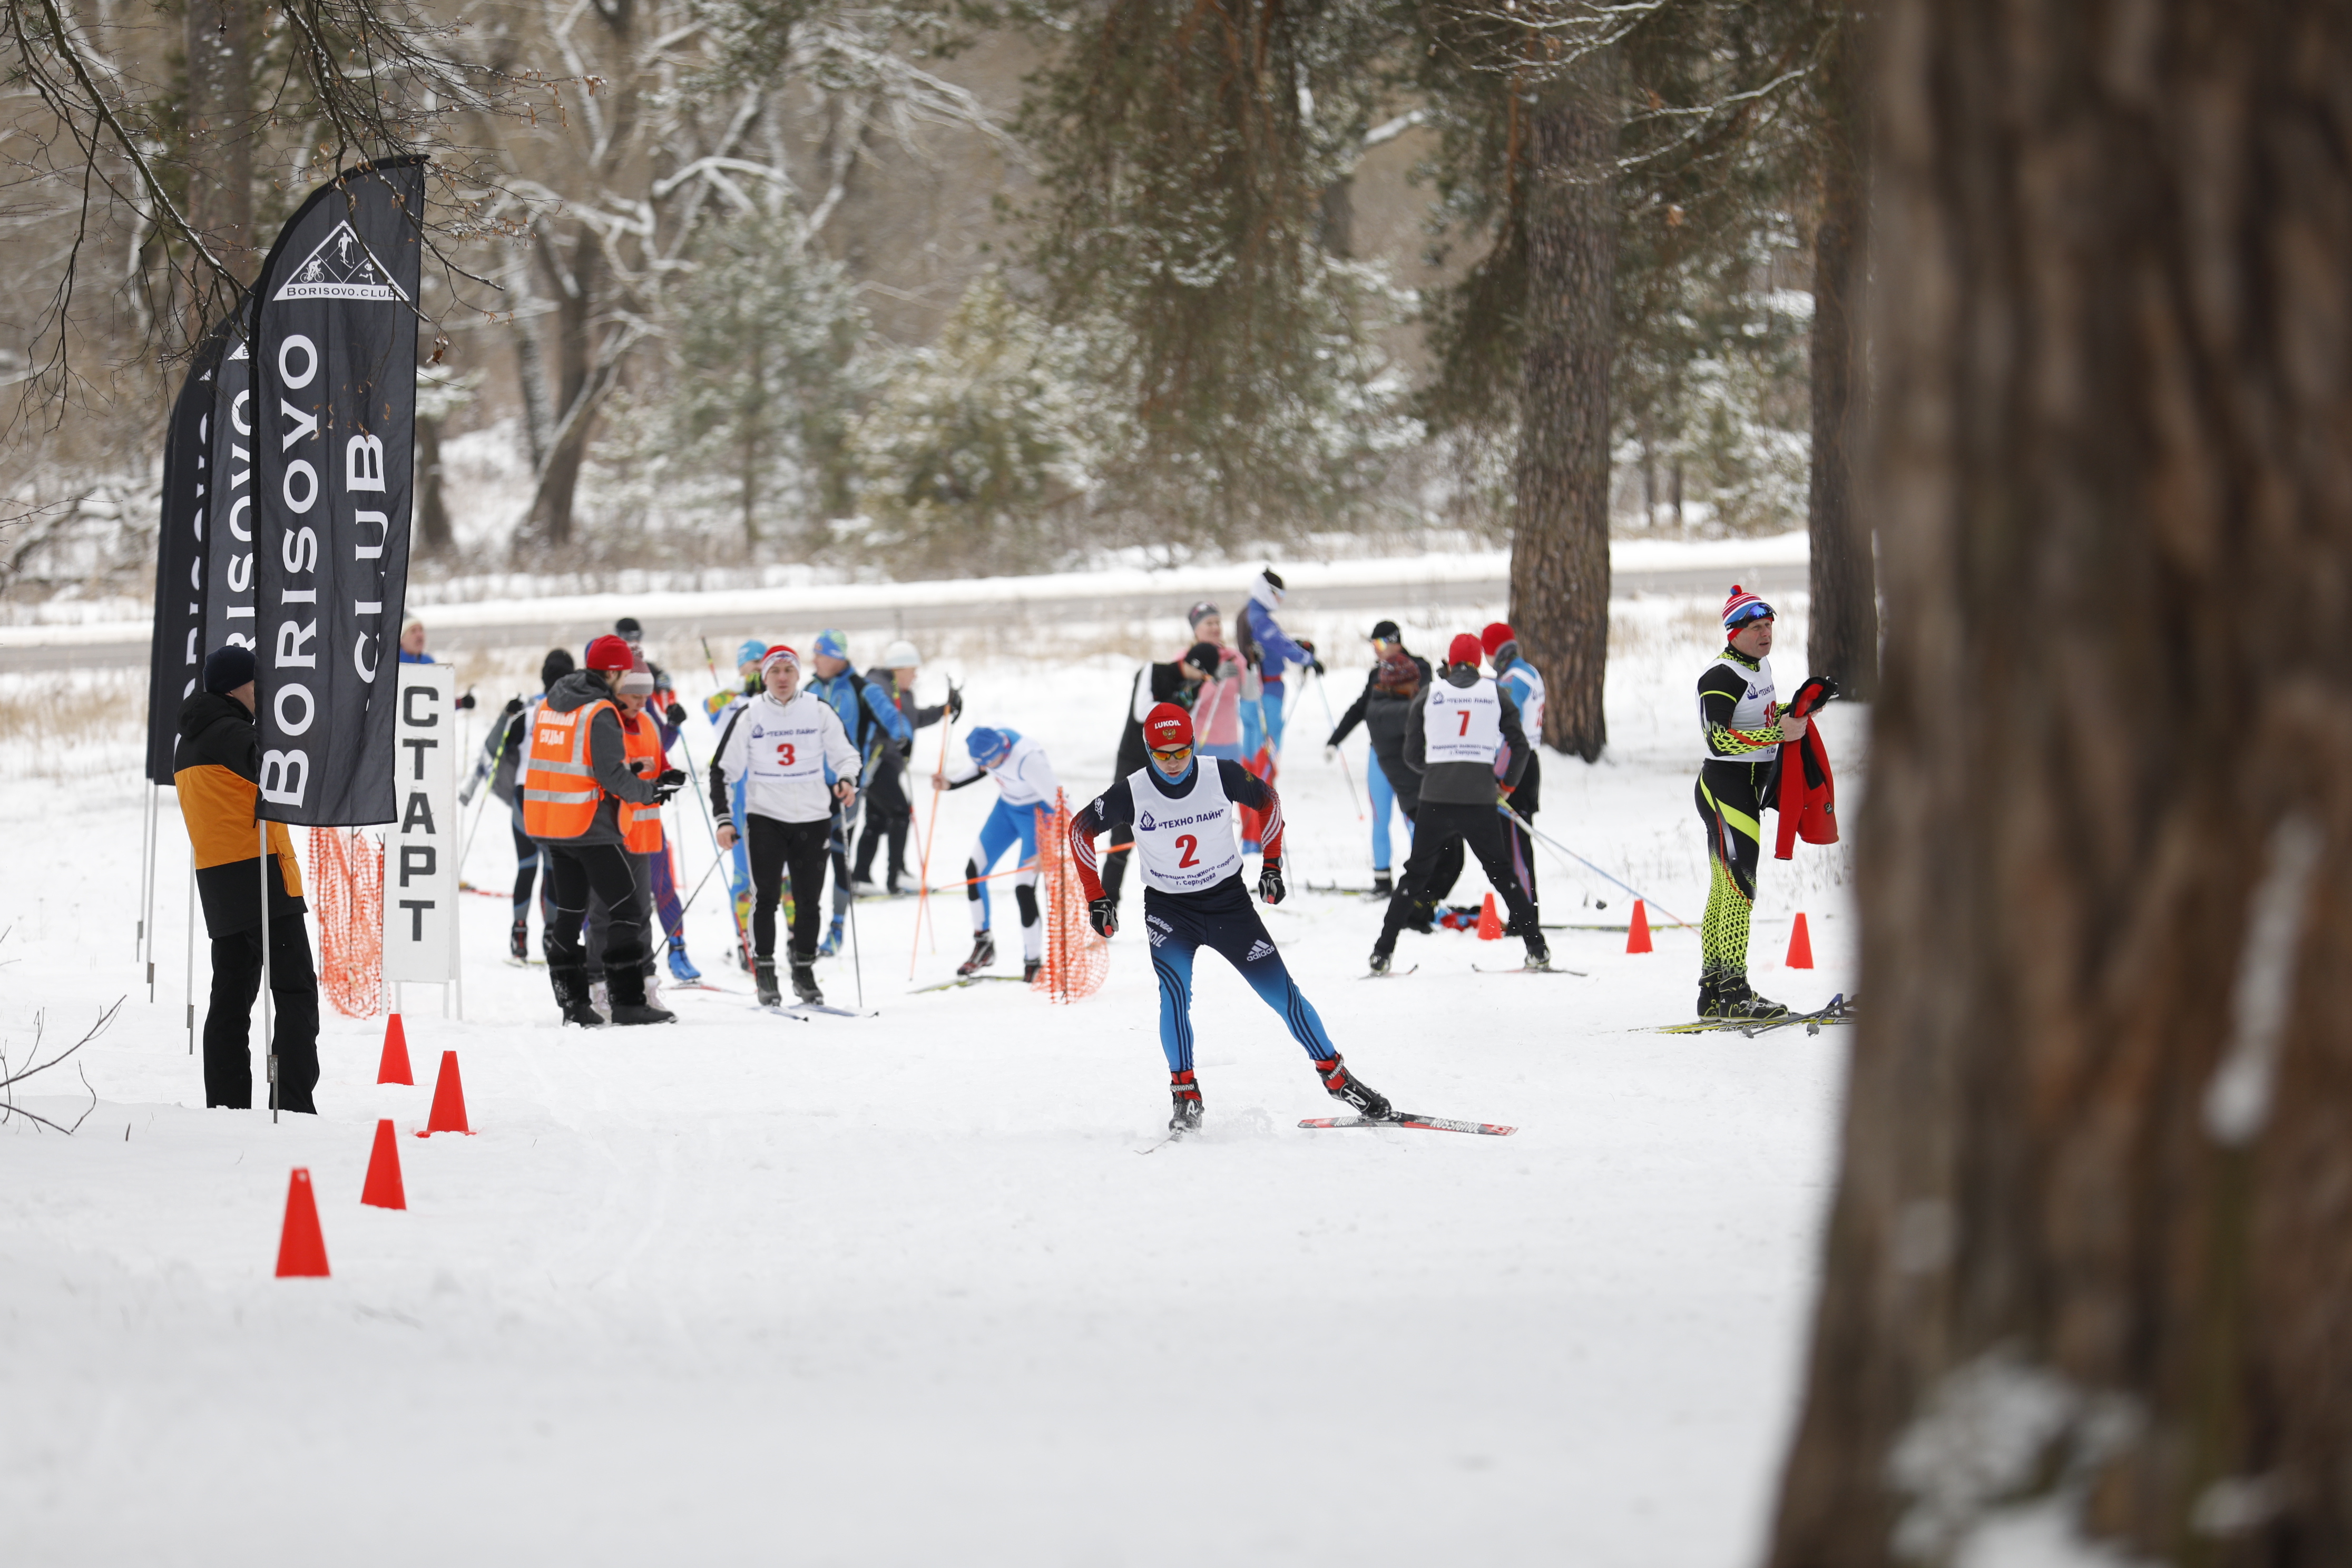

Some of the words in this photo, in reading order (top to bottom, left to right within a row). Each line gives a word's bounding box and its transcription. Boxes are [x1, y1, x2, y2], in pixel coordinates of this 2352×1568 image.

[259, 334, 318, 808] BORISOVO
[1154, 720, 1181, 729] LUKOIL
[1457, 710, 1471, 737] 7
[777, 742, 796, 766] 3
[399, 686, 439, 942] СТАРТ
[1159, 816, 1193, 829] “ТЕХНО
[1195, 808, 1224, 823] ЛАЙН”
[1175, 834, 1200, 869] 2
[1217, 854, 1235, 868] спорта
[1182, 872, 1217, 886] Серпухова
[1146, 914, 1173, 933] SCANIA
[1247, 945, 1275, 962] adidas
[1429, 1118, 1483, 1133] ROSSIGNOL
